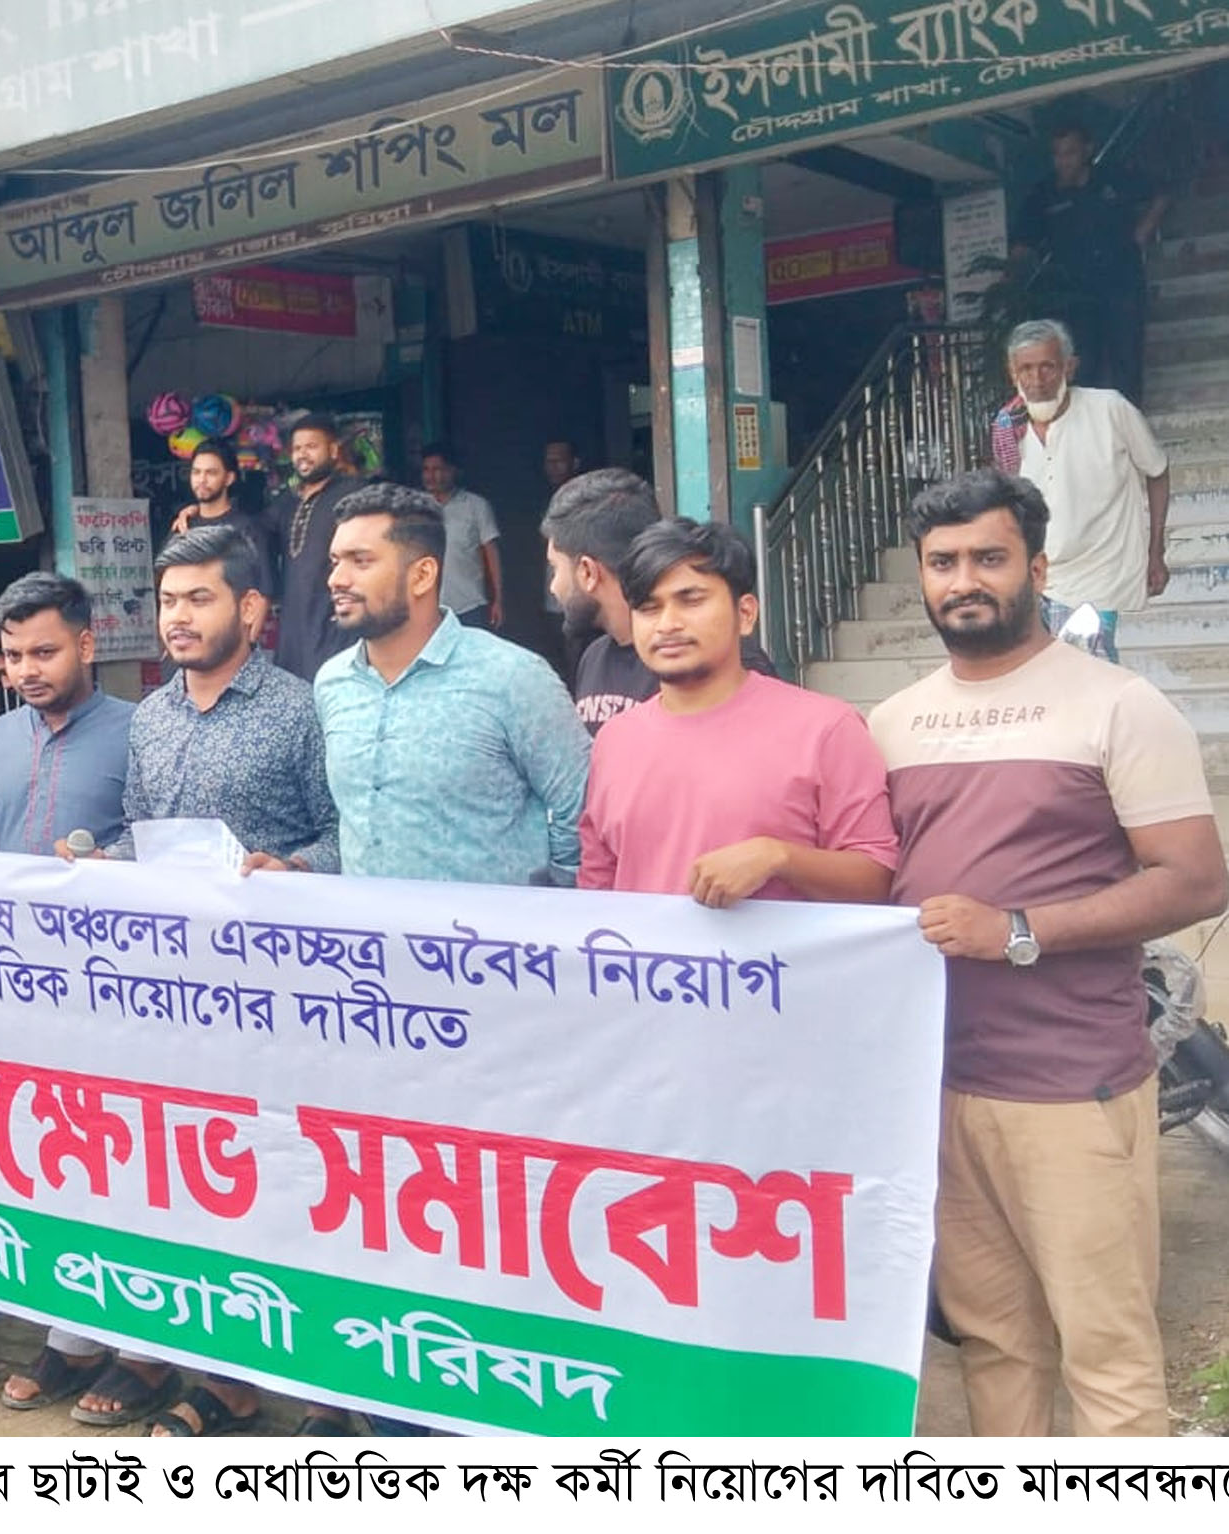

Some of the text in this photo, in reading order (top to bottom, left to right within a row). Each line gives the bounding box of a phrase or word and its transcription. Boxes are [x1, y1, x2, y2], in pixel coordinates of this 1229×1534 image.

[695, 0, 1038, 121] ইসলামী ব্যাংক
[5, 87, 583, 265] আব্দুল জলিল শপিং মল
[911, 705, 1046, 731] PULL&BEAR
[29, 900, 191, 959] অঞ্চলের
[211, 919, 388, 980] একচ্ছত্র
[404, 919, 560, 995] অবৈধ
[577, 928, 790, 1014] নিয়োগ
[82, 955, 277, 1032] নিয়োগের
[292, 979, 471, 1050] দাবীতে
[296, 1104, 854, 1323] সমাবেশ
[53, 1249, 302, 1354] প্রত্যাশী
[333, 1309, 623, 1422] পরিষদ
